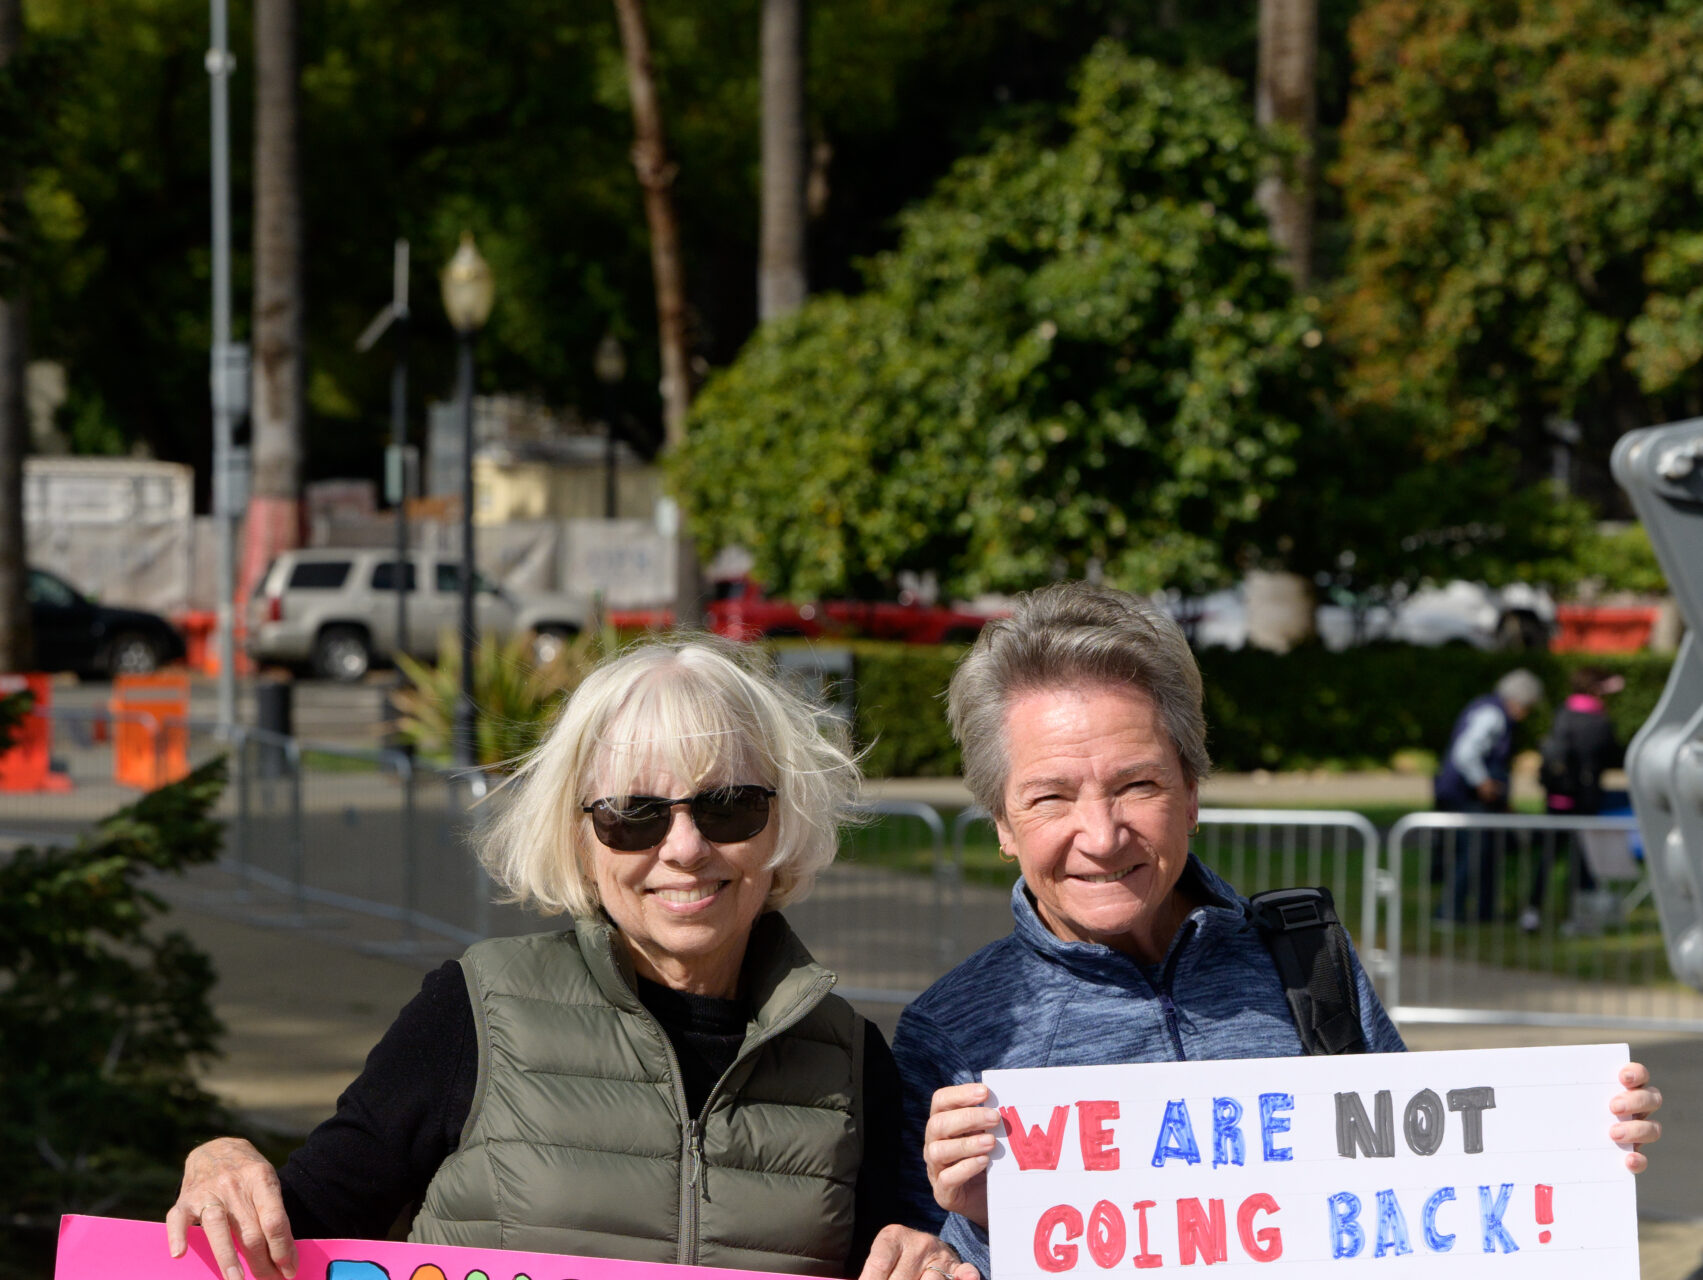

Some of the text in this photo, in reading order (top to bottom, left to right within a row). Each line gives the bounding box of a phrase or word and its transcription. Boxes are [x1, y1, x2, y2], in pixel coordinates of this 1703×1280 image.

[1000, 1086, 1495, 1172] WE ARE NOT
[1033, 1183, 1554, 1273] GOING BACK!
